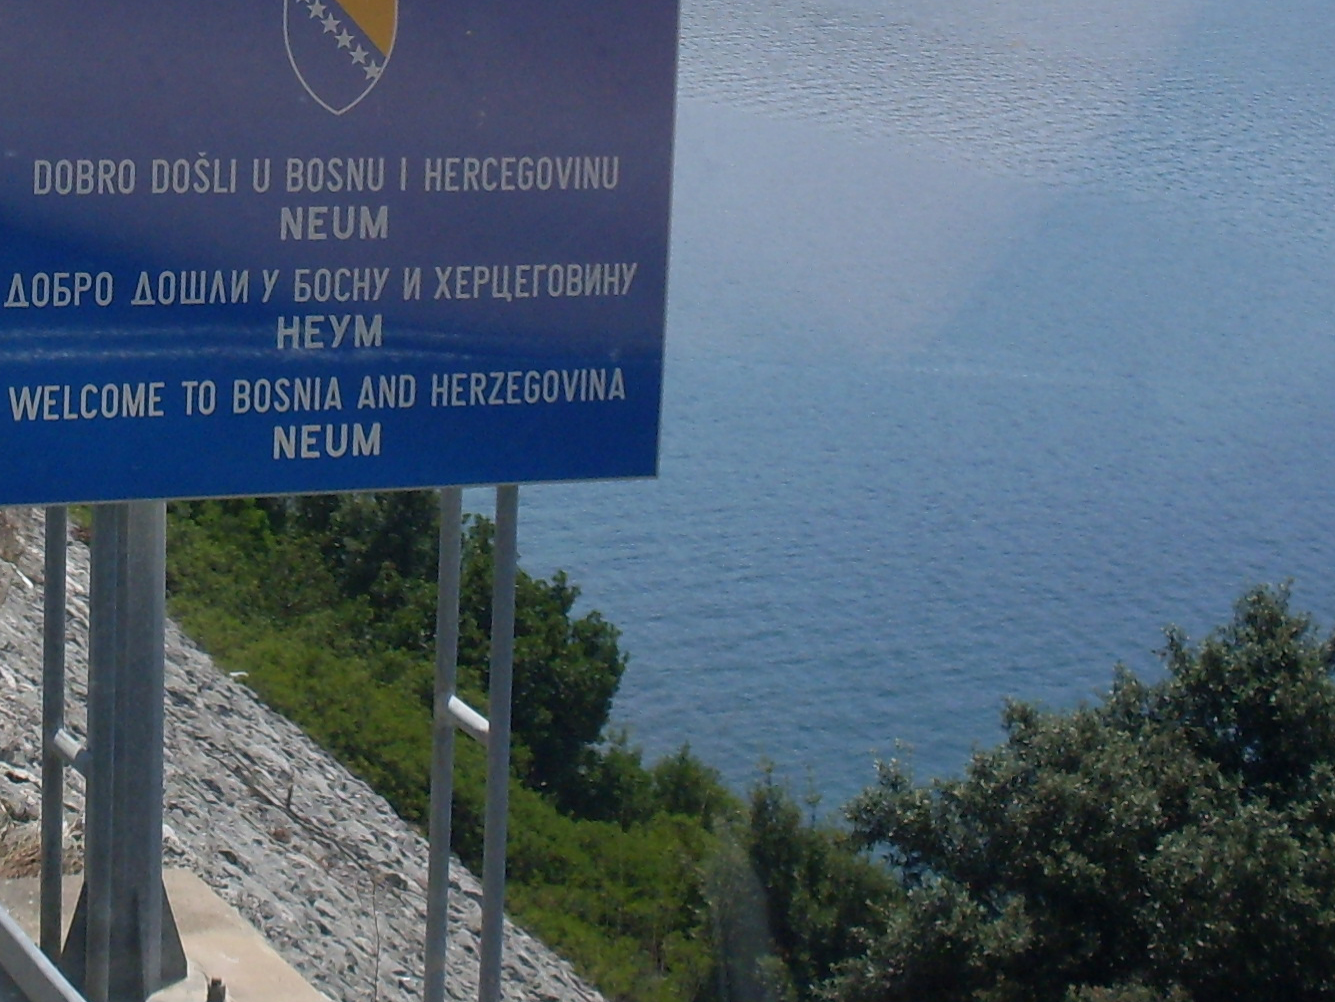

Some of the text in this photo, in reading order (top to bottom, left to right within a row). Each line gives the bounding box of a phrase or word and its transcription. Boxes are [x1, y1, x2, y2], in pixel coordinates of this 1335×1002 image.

[33, 152, 620, 196] DOBRO DOŠLI U BOSNU I HERCEGOVINU
[280, 205, 389, 242] NEUM
[4, 262, 638, 309] ДОБРО ДОШЛИ У БОСНУ И ХЕРЦЕГОВИНУ
[276, 314, 383, 350] НЕУМ
[8, 368, 626, 422] WELCOME TO BOSNIA AND HERZEGOVINA
[272, 422, 382, 460] NEUM
